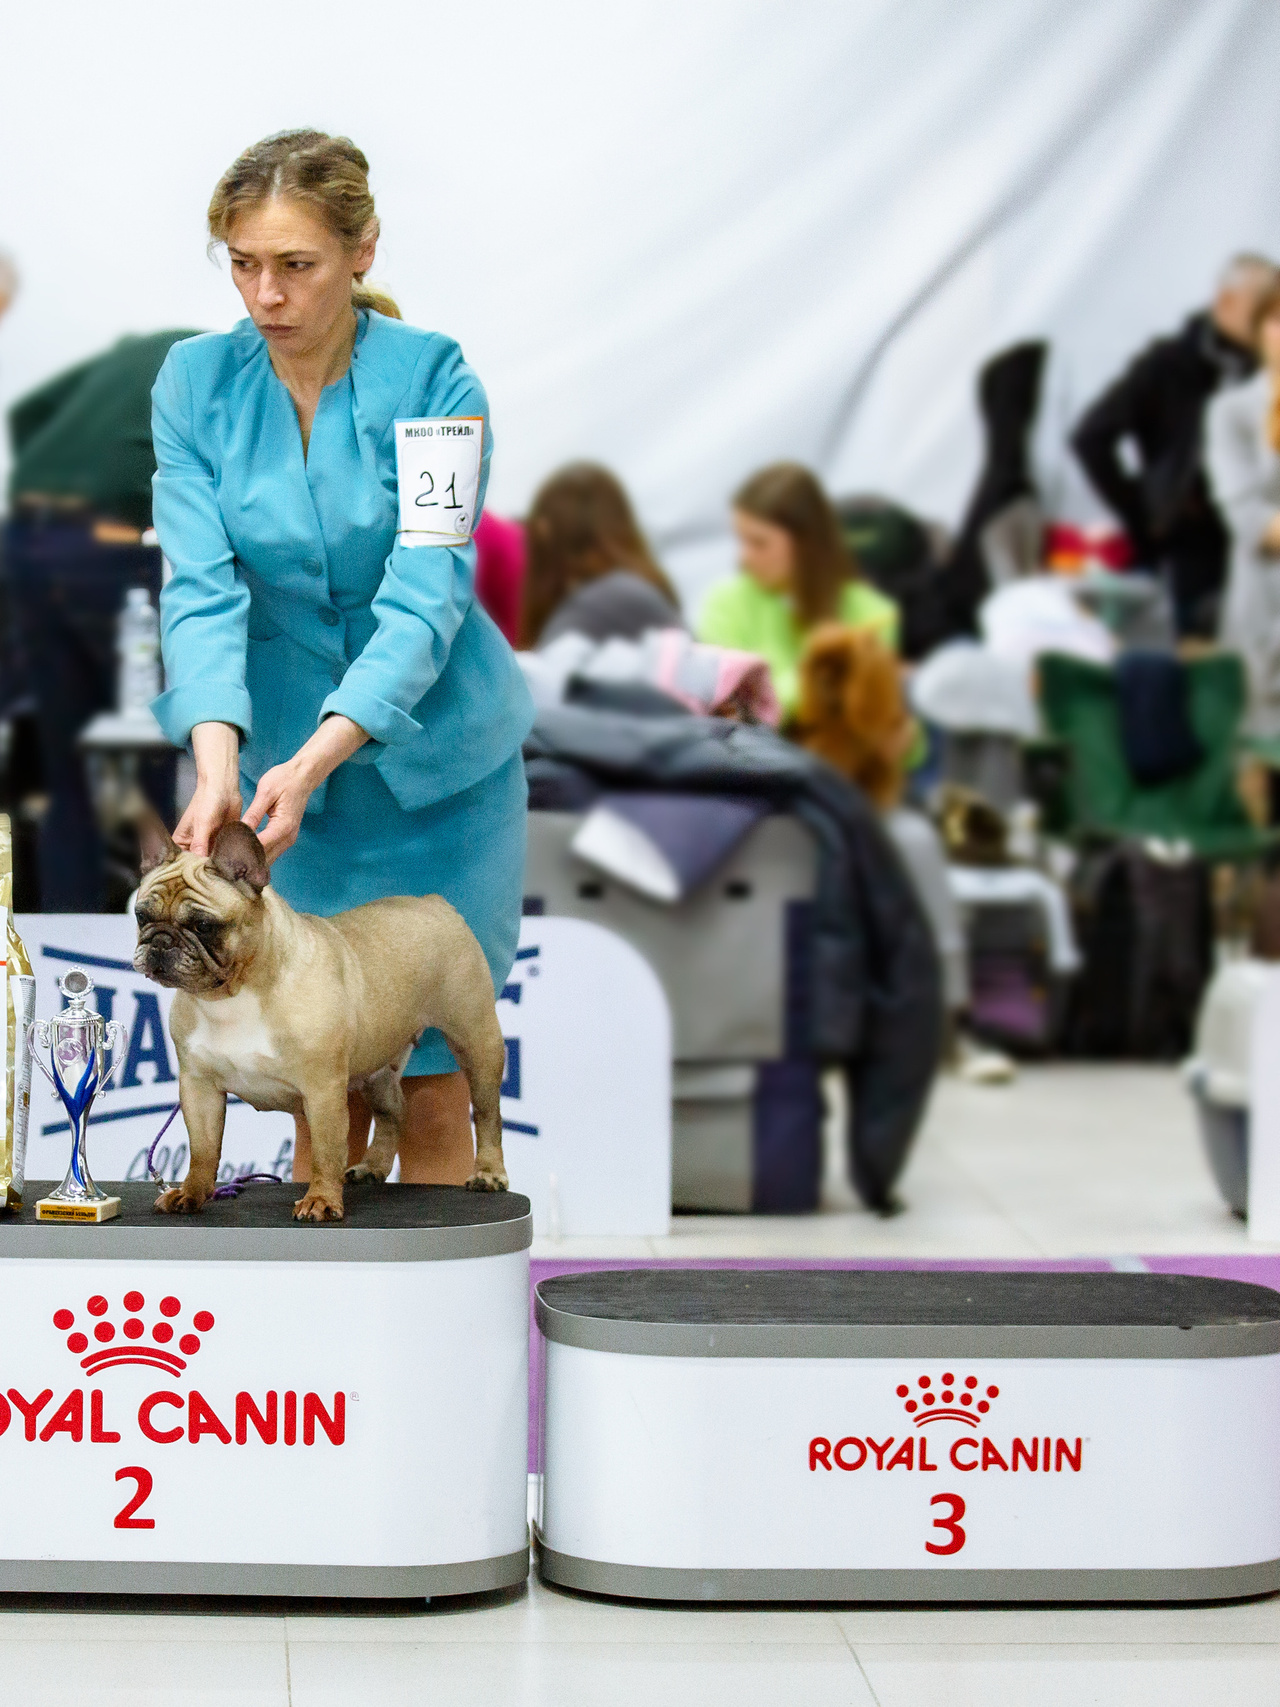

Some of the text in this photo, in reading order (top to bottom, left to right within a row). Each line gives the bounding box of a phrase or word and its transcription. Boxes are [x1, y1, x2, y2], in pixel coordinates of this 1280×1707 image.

[405, 427, 433, 438] МКОО
[415, 471, 463, 509] 21
[137, 1390, 346, 1446] CANIN
[808, 1436, 1082, 1472] ROYAL CANIN
[113, 1465, 156, 1529] 2
[924, 1492, 967, 1556] 3
